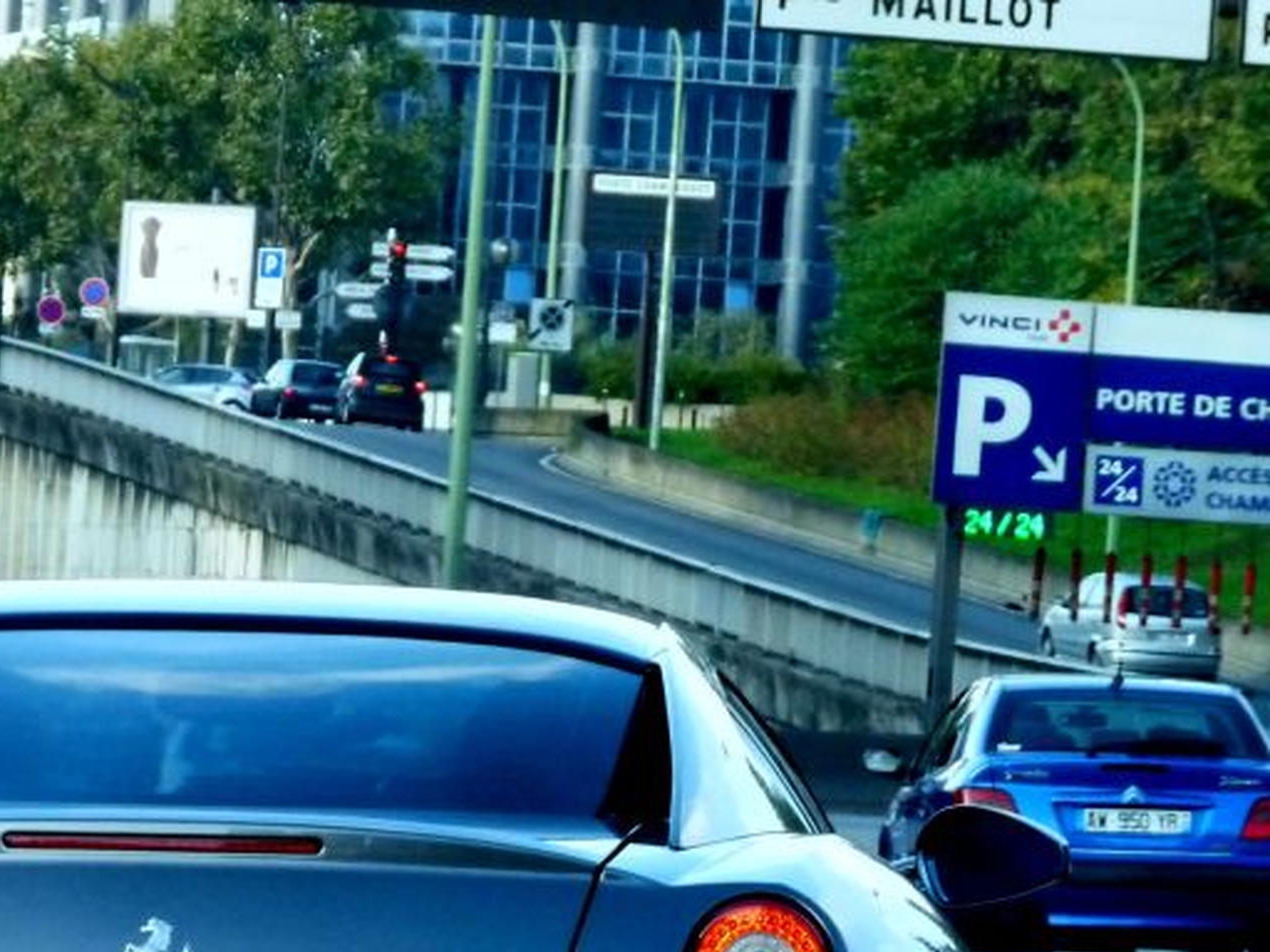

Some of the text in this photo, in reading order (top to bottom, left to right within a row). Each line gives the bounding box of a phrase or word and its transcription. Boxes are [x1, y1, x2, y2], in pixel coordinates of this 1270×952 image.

[958, 311, 1042, 332] VINCI
[1096, 387, 1187, 416] PORTE
[1193, 394, 1232, 419] DE
[952, 373, 1033, 478] P
